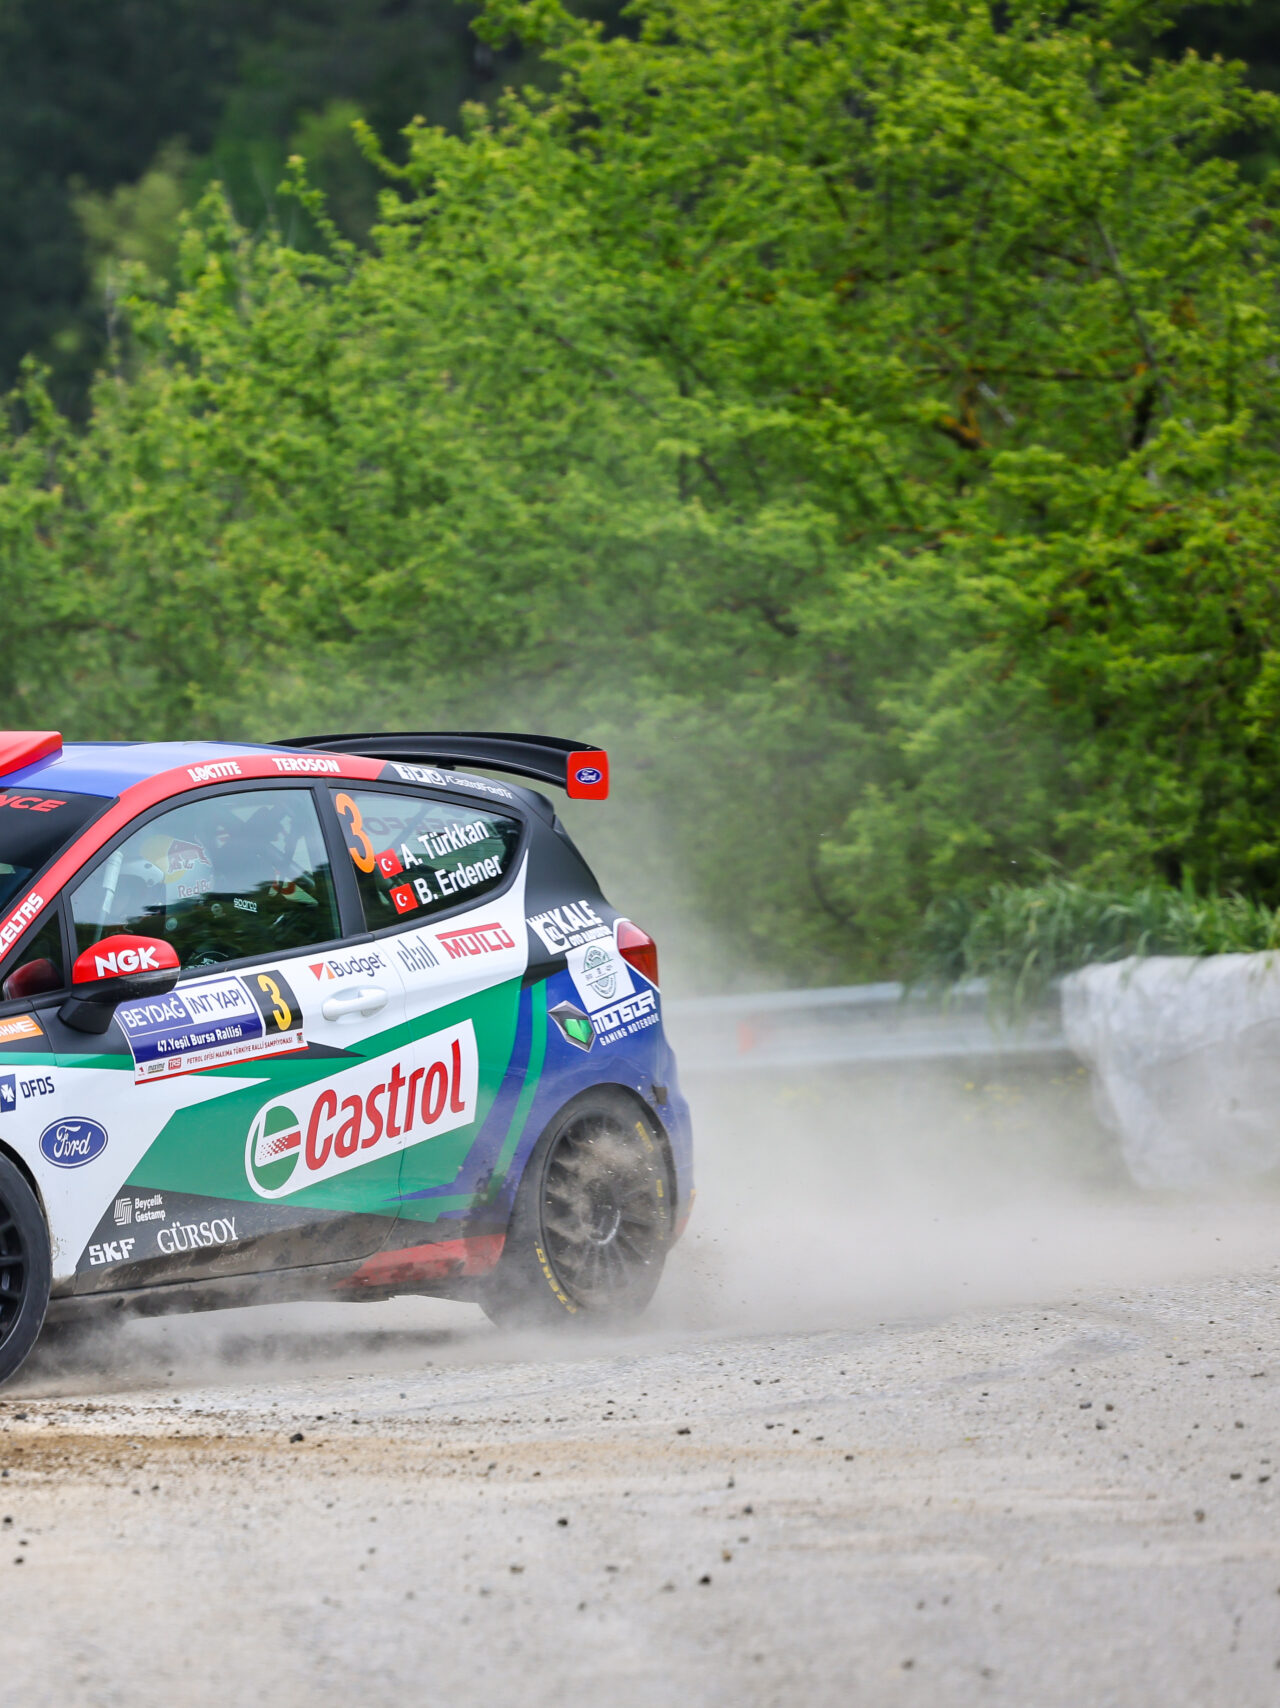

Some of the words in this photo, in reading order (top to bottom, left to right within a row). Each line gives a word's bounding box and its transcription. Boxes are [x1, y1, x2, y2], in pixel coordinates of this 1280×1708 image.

[187, 762, 242, 782] LOCTITE
[272, 758, 341, 773] TEROSON
[335, 793, 376, 874] 3
[401, 844, 423, 869] A.
[417, 820, 490, 860] Türkkan
[414, 877, 439, 904] B.
[434, 855, 503, 896] Erdener
[548, 900, 605, 934] KALE
[435, 922, 516, 960] MUTLU
[94, 946, 160, 977] NGK
[328, 952, 387, 977] Budget
[121, 998, 187, 1028] BEYDAĞ
[210, 988, 247, 1010] YAPI
[257, 974, 292, 1031] 3
[191, 1030, 216, 1048] Bursa
[216, 1025, 243, 1043] Rallisi
[599, 1027, 628, 1046] GAMING
[19, 1076, 55, 1099] DFDS
[305, 1038, 465, 1171] Castrol
[53, 1125, 92, 1159] Ford
[135, 1194, 163, 1211] Beyçelik
[135, 1209, 166, 1223] Gestamp
[157, 1216, 239, 1254] GÜRSOY
[89, 1237, 136, 1266] SKF
